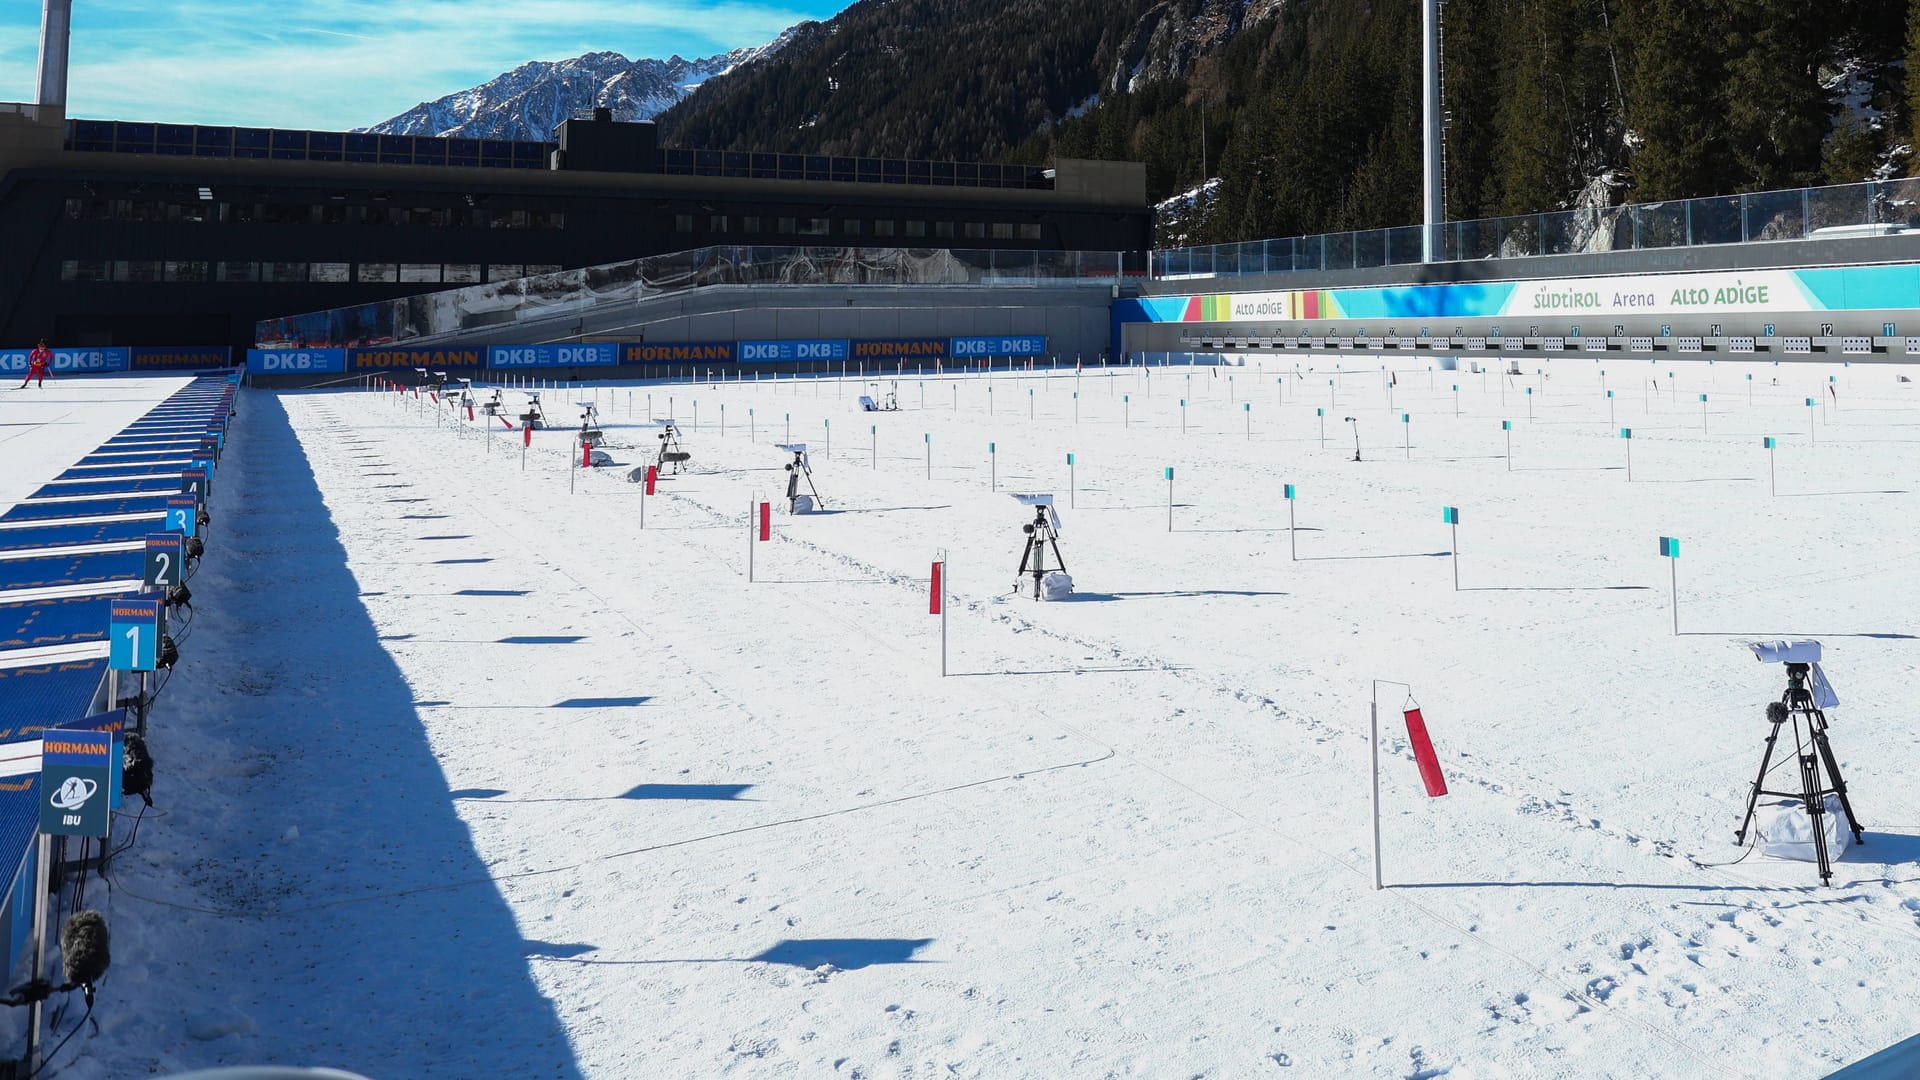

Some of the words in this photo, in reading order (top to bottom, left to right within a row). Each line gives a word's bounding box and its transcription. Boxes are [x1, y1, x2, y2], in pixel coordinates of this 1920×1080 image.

[1612, 292, 1655, 307] Arena
[1530, 326, 1538, 336] 18
[1572, 326, 1580, 336] 17
[1615, 325, 1623, 336] 16
[1661, 325, 1670, 336] 15
[1711, 325, 1721, 336] 14
[1765, 324, 1775, 336] 13
[1821, 324, 1832, 336] 12
[1884, 324, 1895, 336] 11
[744, 345, 778, 359] DKB
[797, 343, 830, 357] DKB
[956, 341, 986, 354] DKB
[1002, 340, 1031, 353] DKB
[54, 351, 103, 369] DKB
[263, 353, 311, 370] DKB
[356, 350, 478, 367] HÖRMANN
[495, 349, 536, 364] DKB
[558, 348, 597, 363] DKB
[175, 510, 186, 532] 3
[155, 553, 170, 584] 2
[126, 626, 139, 668] 1
[63, 814, 81, 825] IBU
